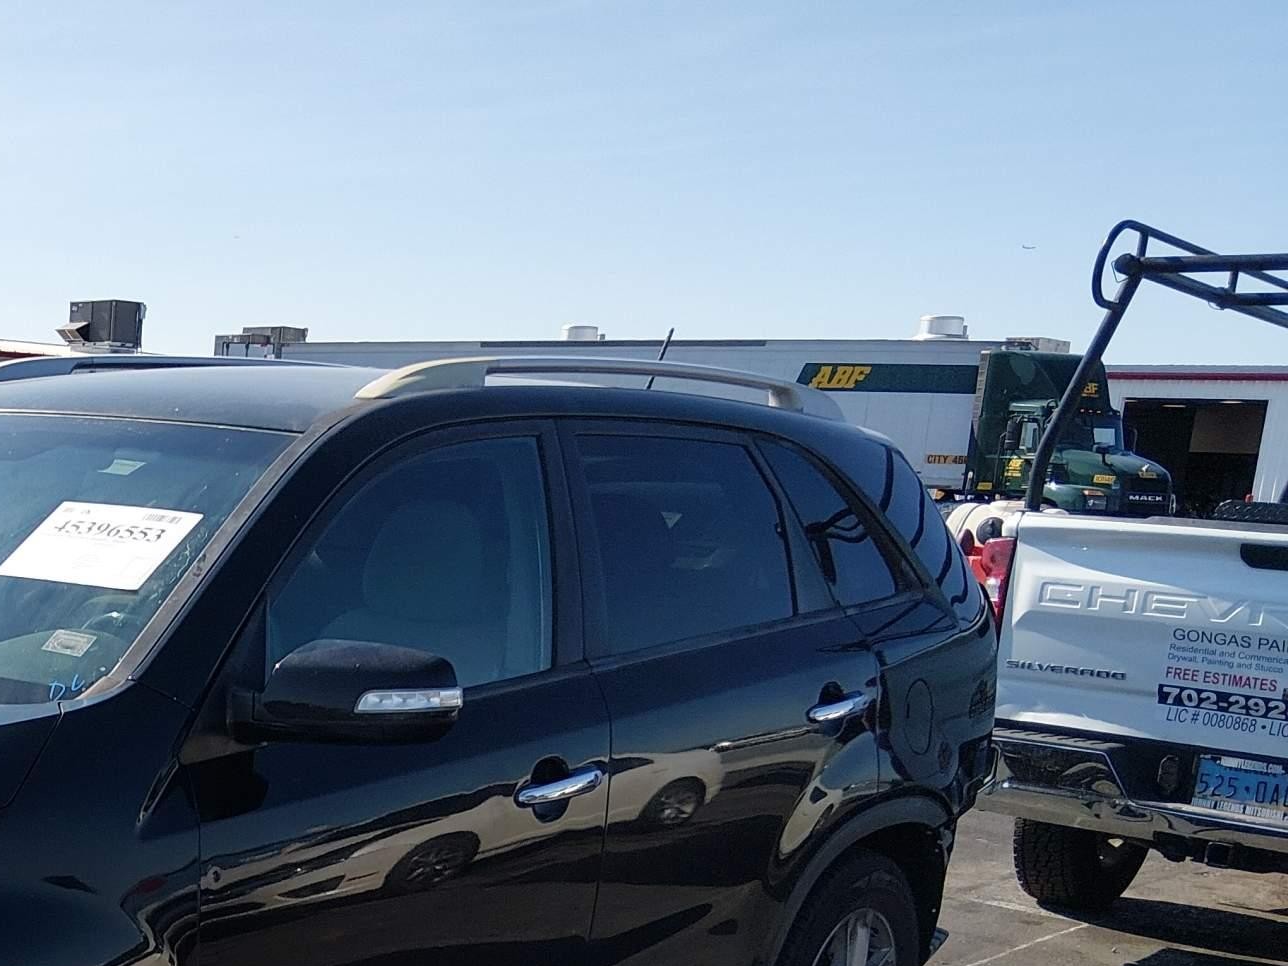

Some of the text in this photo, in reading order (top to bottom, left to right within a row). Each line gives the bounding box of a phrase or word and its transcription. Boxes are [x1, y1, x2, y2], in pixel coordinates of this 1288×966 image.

[809, 366, 872, 388] ABF
[927, 455, 949, 464] CITY
[54, 519, 166, 543] 45396553
[1173, 628, 1252, 649] GONGAS
[1169, 643, 1217, 656] Residential
[1219, 650, 1235, 659] and
[1006, 659, 1127, 680] SILVERADO
[1201, 656, 1234, 669] Painting
[1236, 661, 1252, 670] and
[1255, 663, 1283, 674] Stucco
[1166, 666, 1278, 692] FREE ESTIMATES
[1166, 706, 1189, 723] LIC
[1191, 709, 1200, 725] #
[1202, 712, 1257, 733] 0080868
